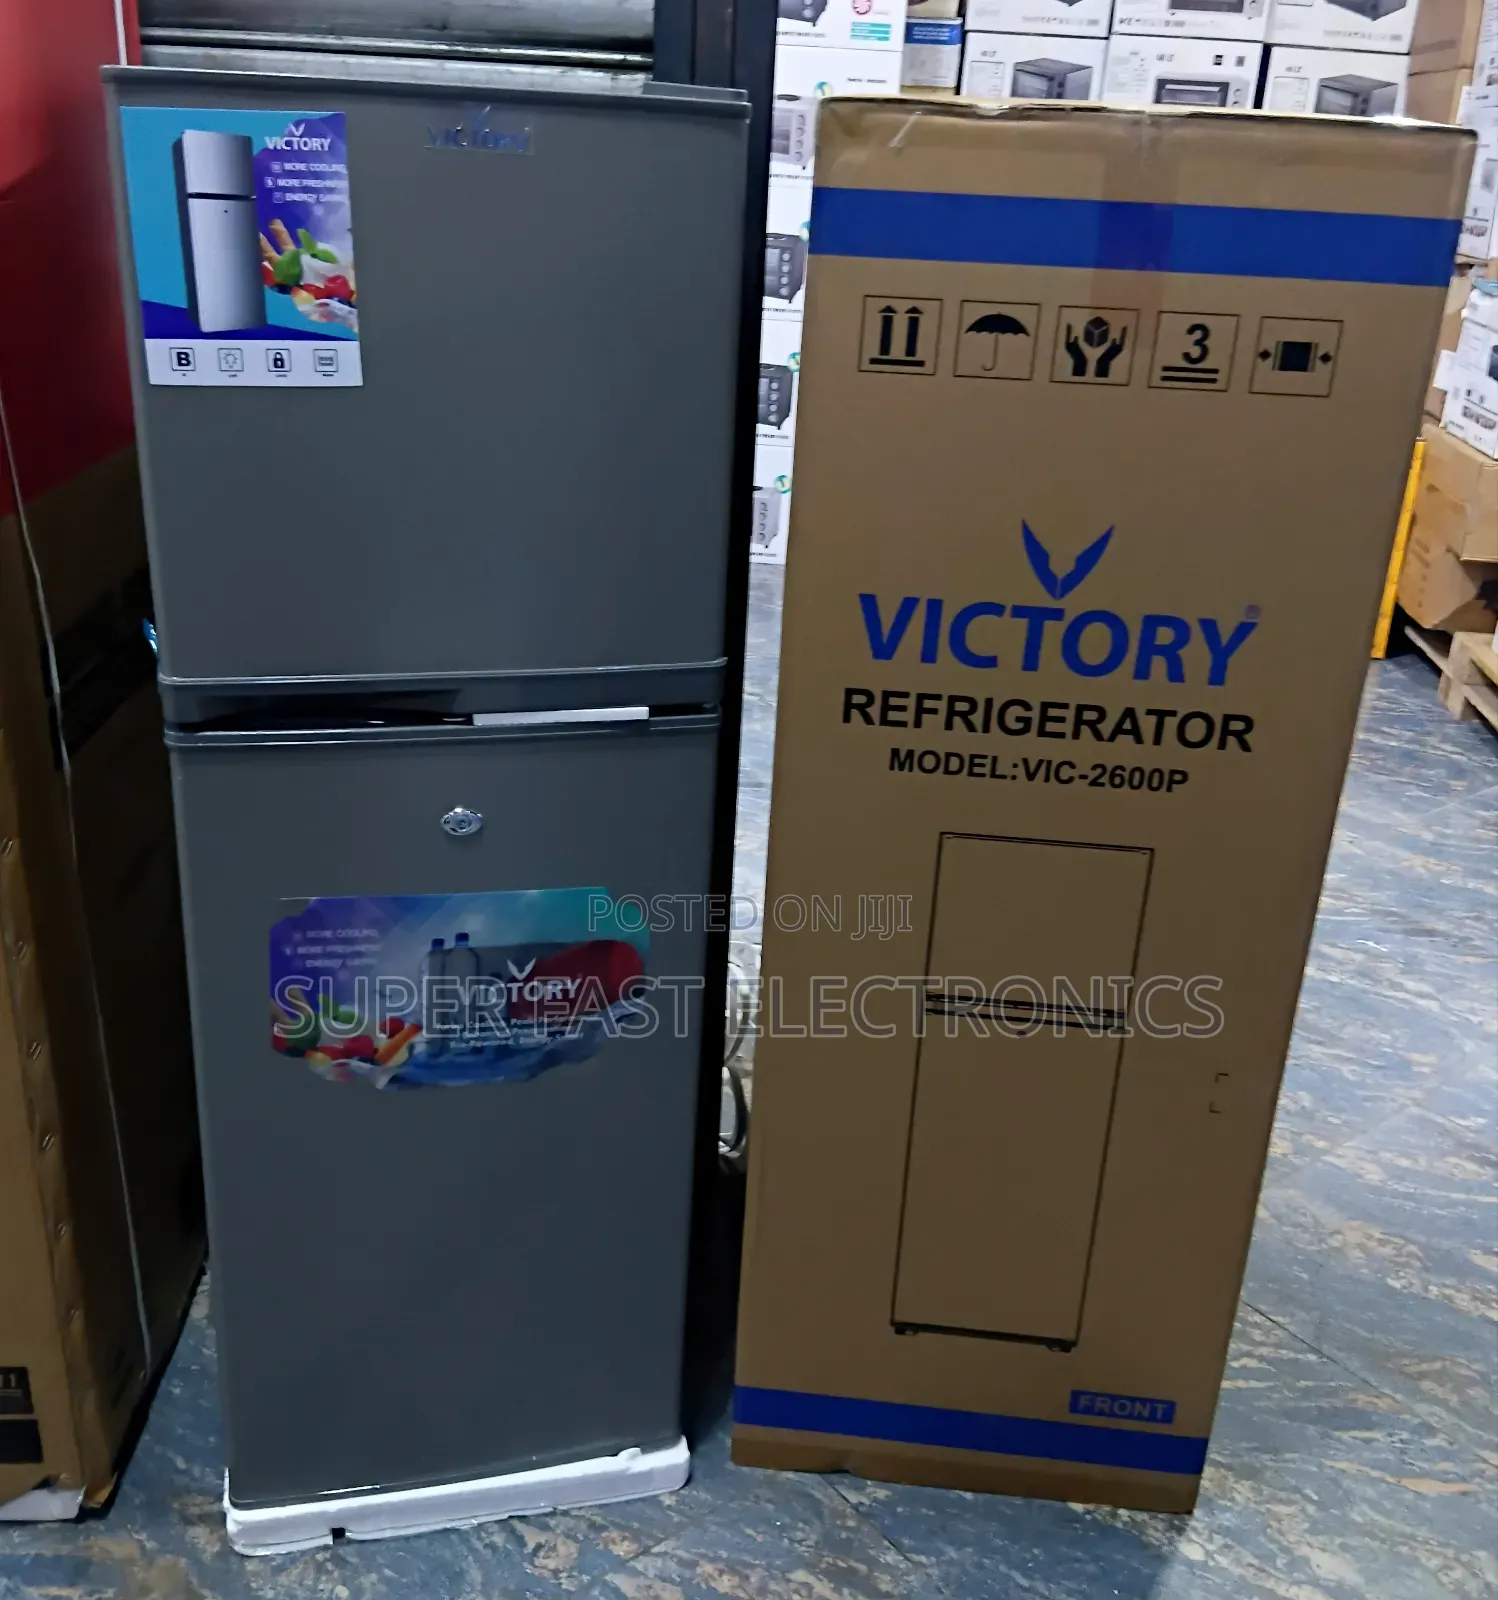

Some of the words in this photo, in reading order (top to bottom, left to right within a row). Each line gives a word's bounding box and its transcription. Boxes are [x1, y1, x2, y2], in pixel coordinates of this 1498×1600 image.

[264, 136, 331, 151] VICTORY
[177, 351, 191, 367] B
[1181, 323, 1210, 365] 3
[858, 593, 1259, 687] VICTORY
[841, 687, 1255, 752] REFRIGERATOR
[888, 747, 1189, 793] MODEL:VIC-2600P
[458, 977, 583, 1006] VICTORY
[1077, 1394, 1169, 1421] FRONT
